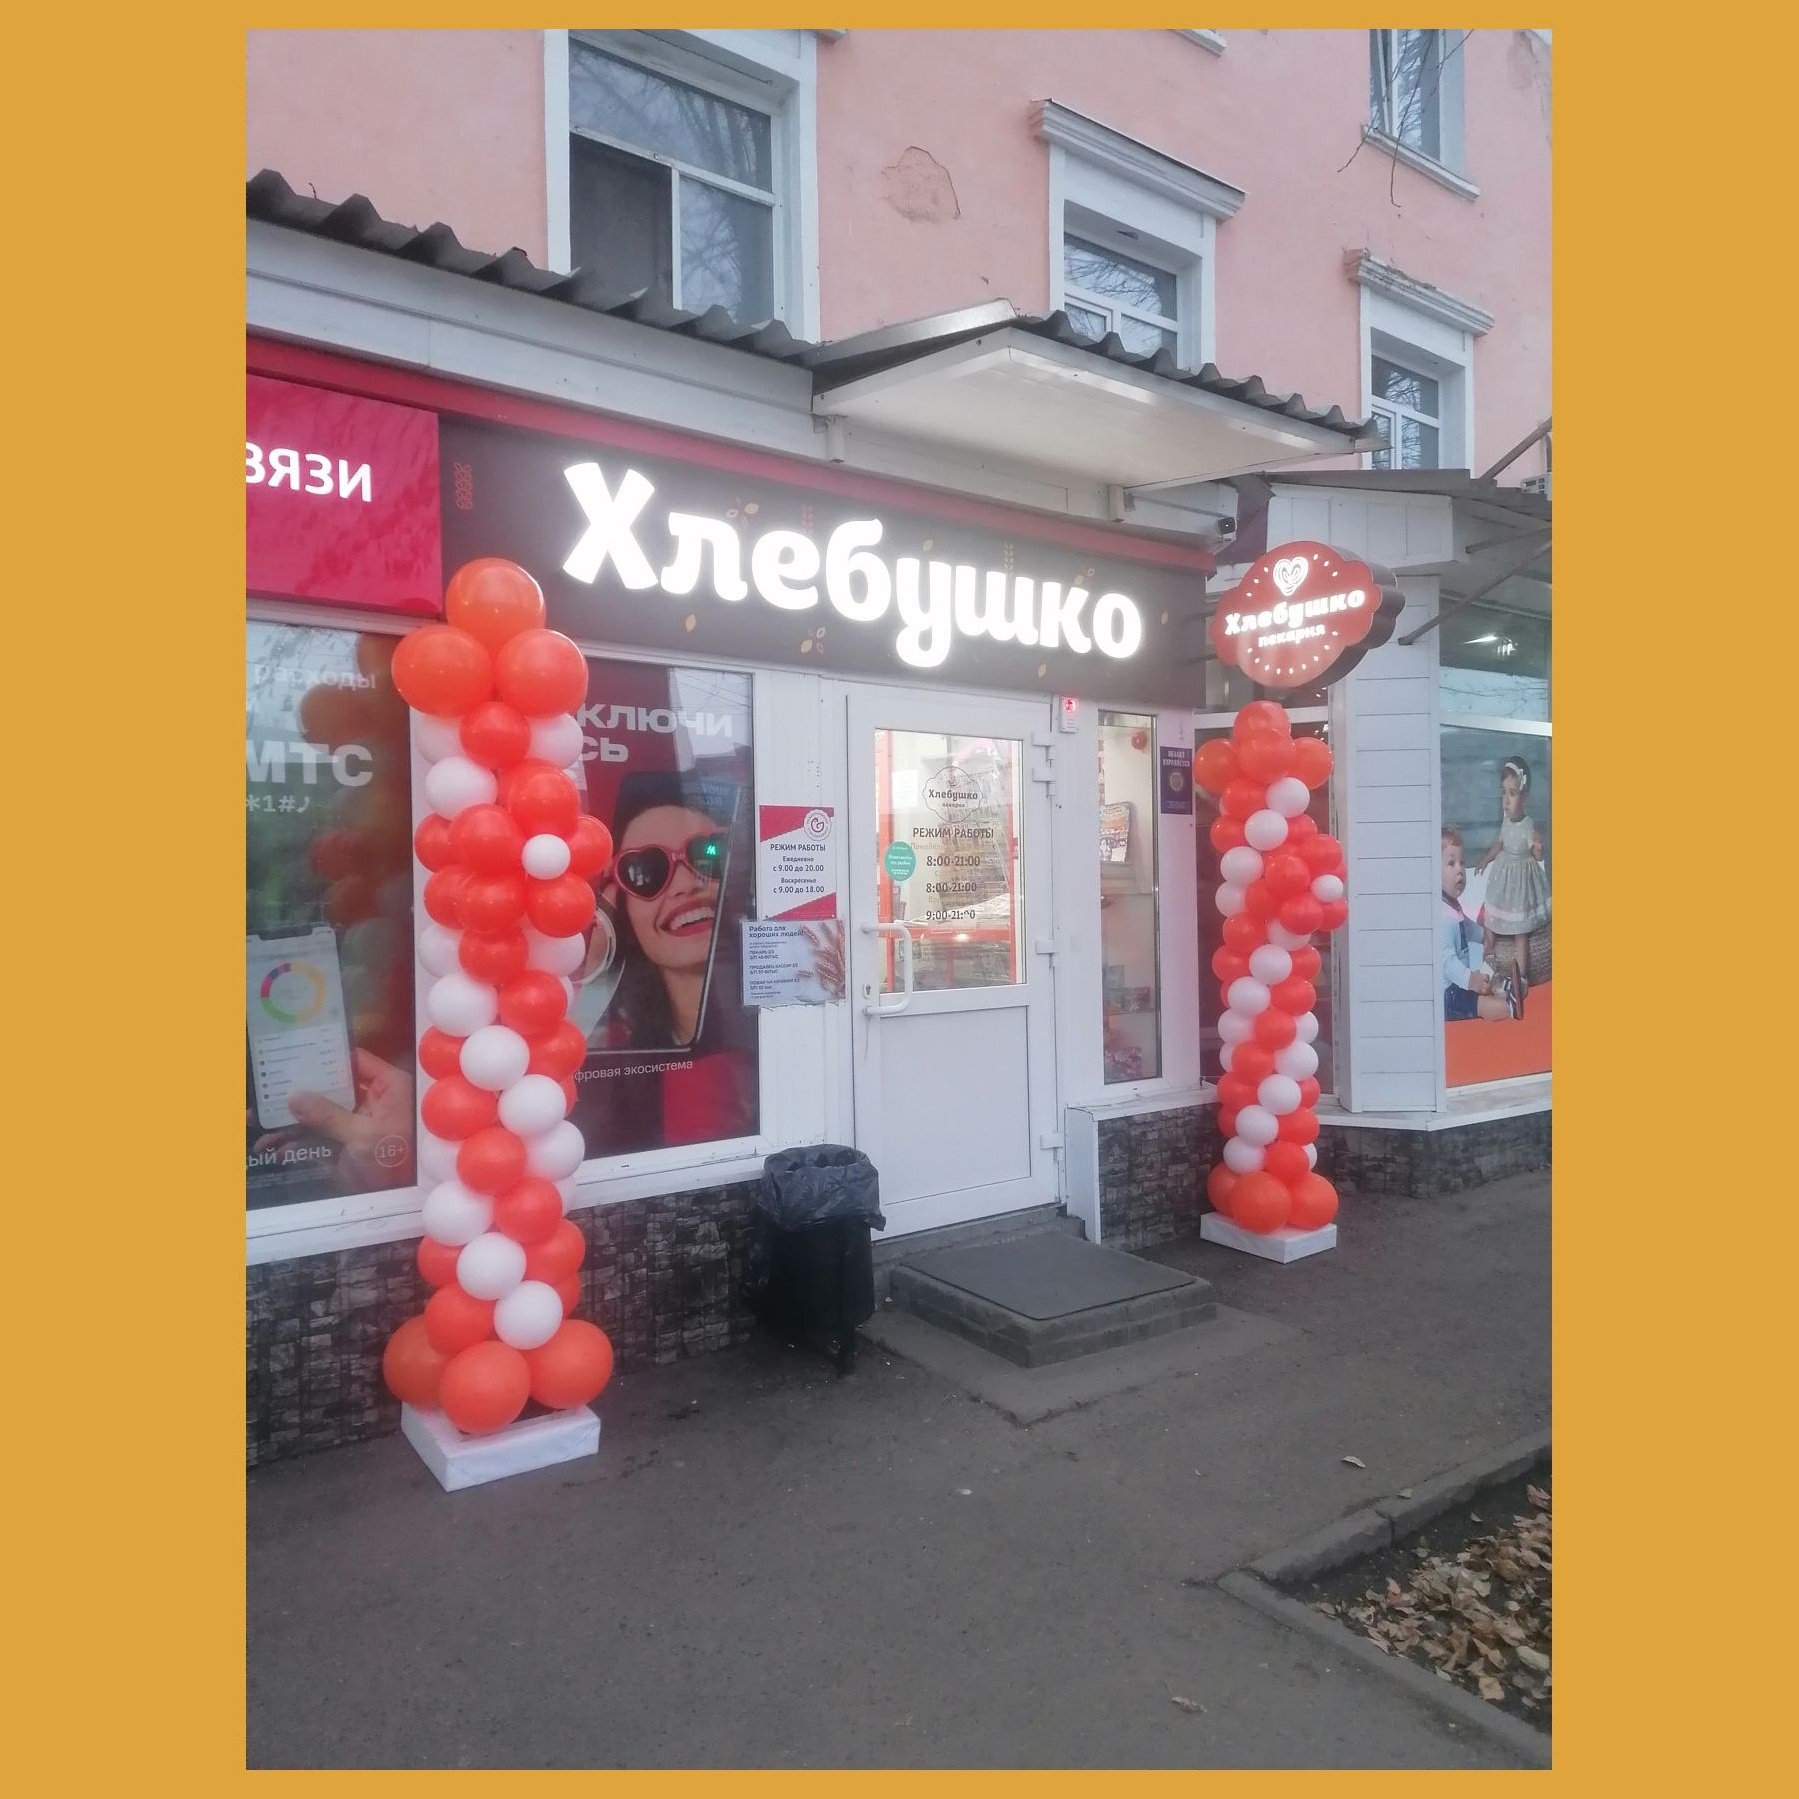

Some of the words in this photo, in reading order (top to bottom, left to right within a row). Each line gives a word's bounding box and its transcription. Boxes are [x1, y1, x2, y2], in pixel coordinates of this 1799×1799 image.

[562, 461, 1142, 668] Хлебушко
[1224, 589, 1366, 636] Хлебушко
[1258, 624, 1326, 648] пекарня
[246, 739, 374, 787] МТС
[928, 789, 978, 801] Хлебушко
[913, 827, 951, 838] РЕЖИМ
[954, 828, 994, 838] РАБОТЫ
[770, 843, 797, 851] РЕЖИМ
[805, 864, 824, 872] 20.00
[926, 909, 976, 920] 9:00-21:0
[574, 1066, 621, 1083] фровая
[624, 1060, 693, 1075] экосистема
[282, 1145, 332, 1166] день
[378, 1144, 406, 1158] 16+
